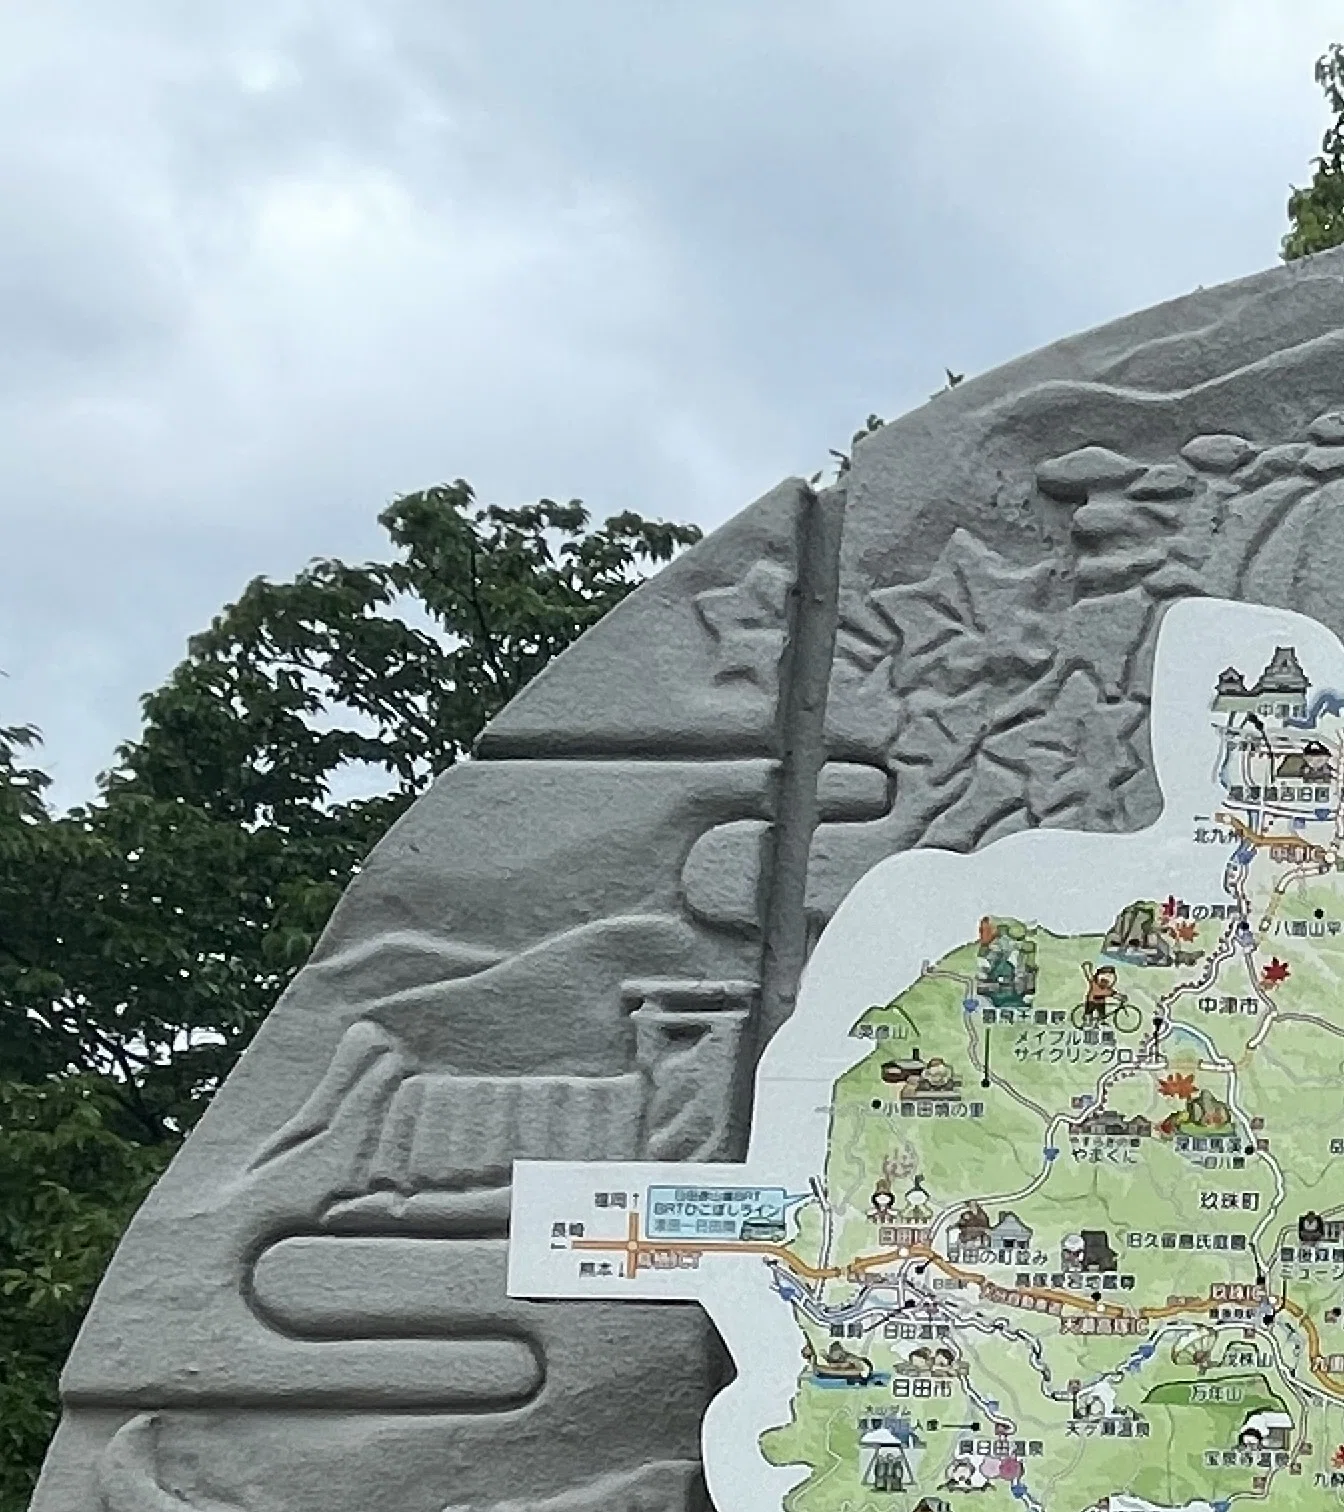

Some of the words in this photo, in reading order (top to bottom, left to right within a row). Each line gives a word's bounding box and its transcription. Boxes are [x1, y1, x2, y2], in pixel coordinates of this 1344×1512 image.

[1199, 997, 1257, 1015] 中津市
[1200, 1192, 1258, 1211] 玖珠町
[893, 1379, 952, 1398] 日田市
